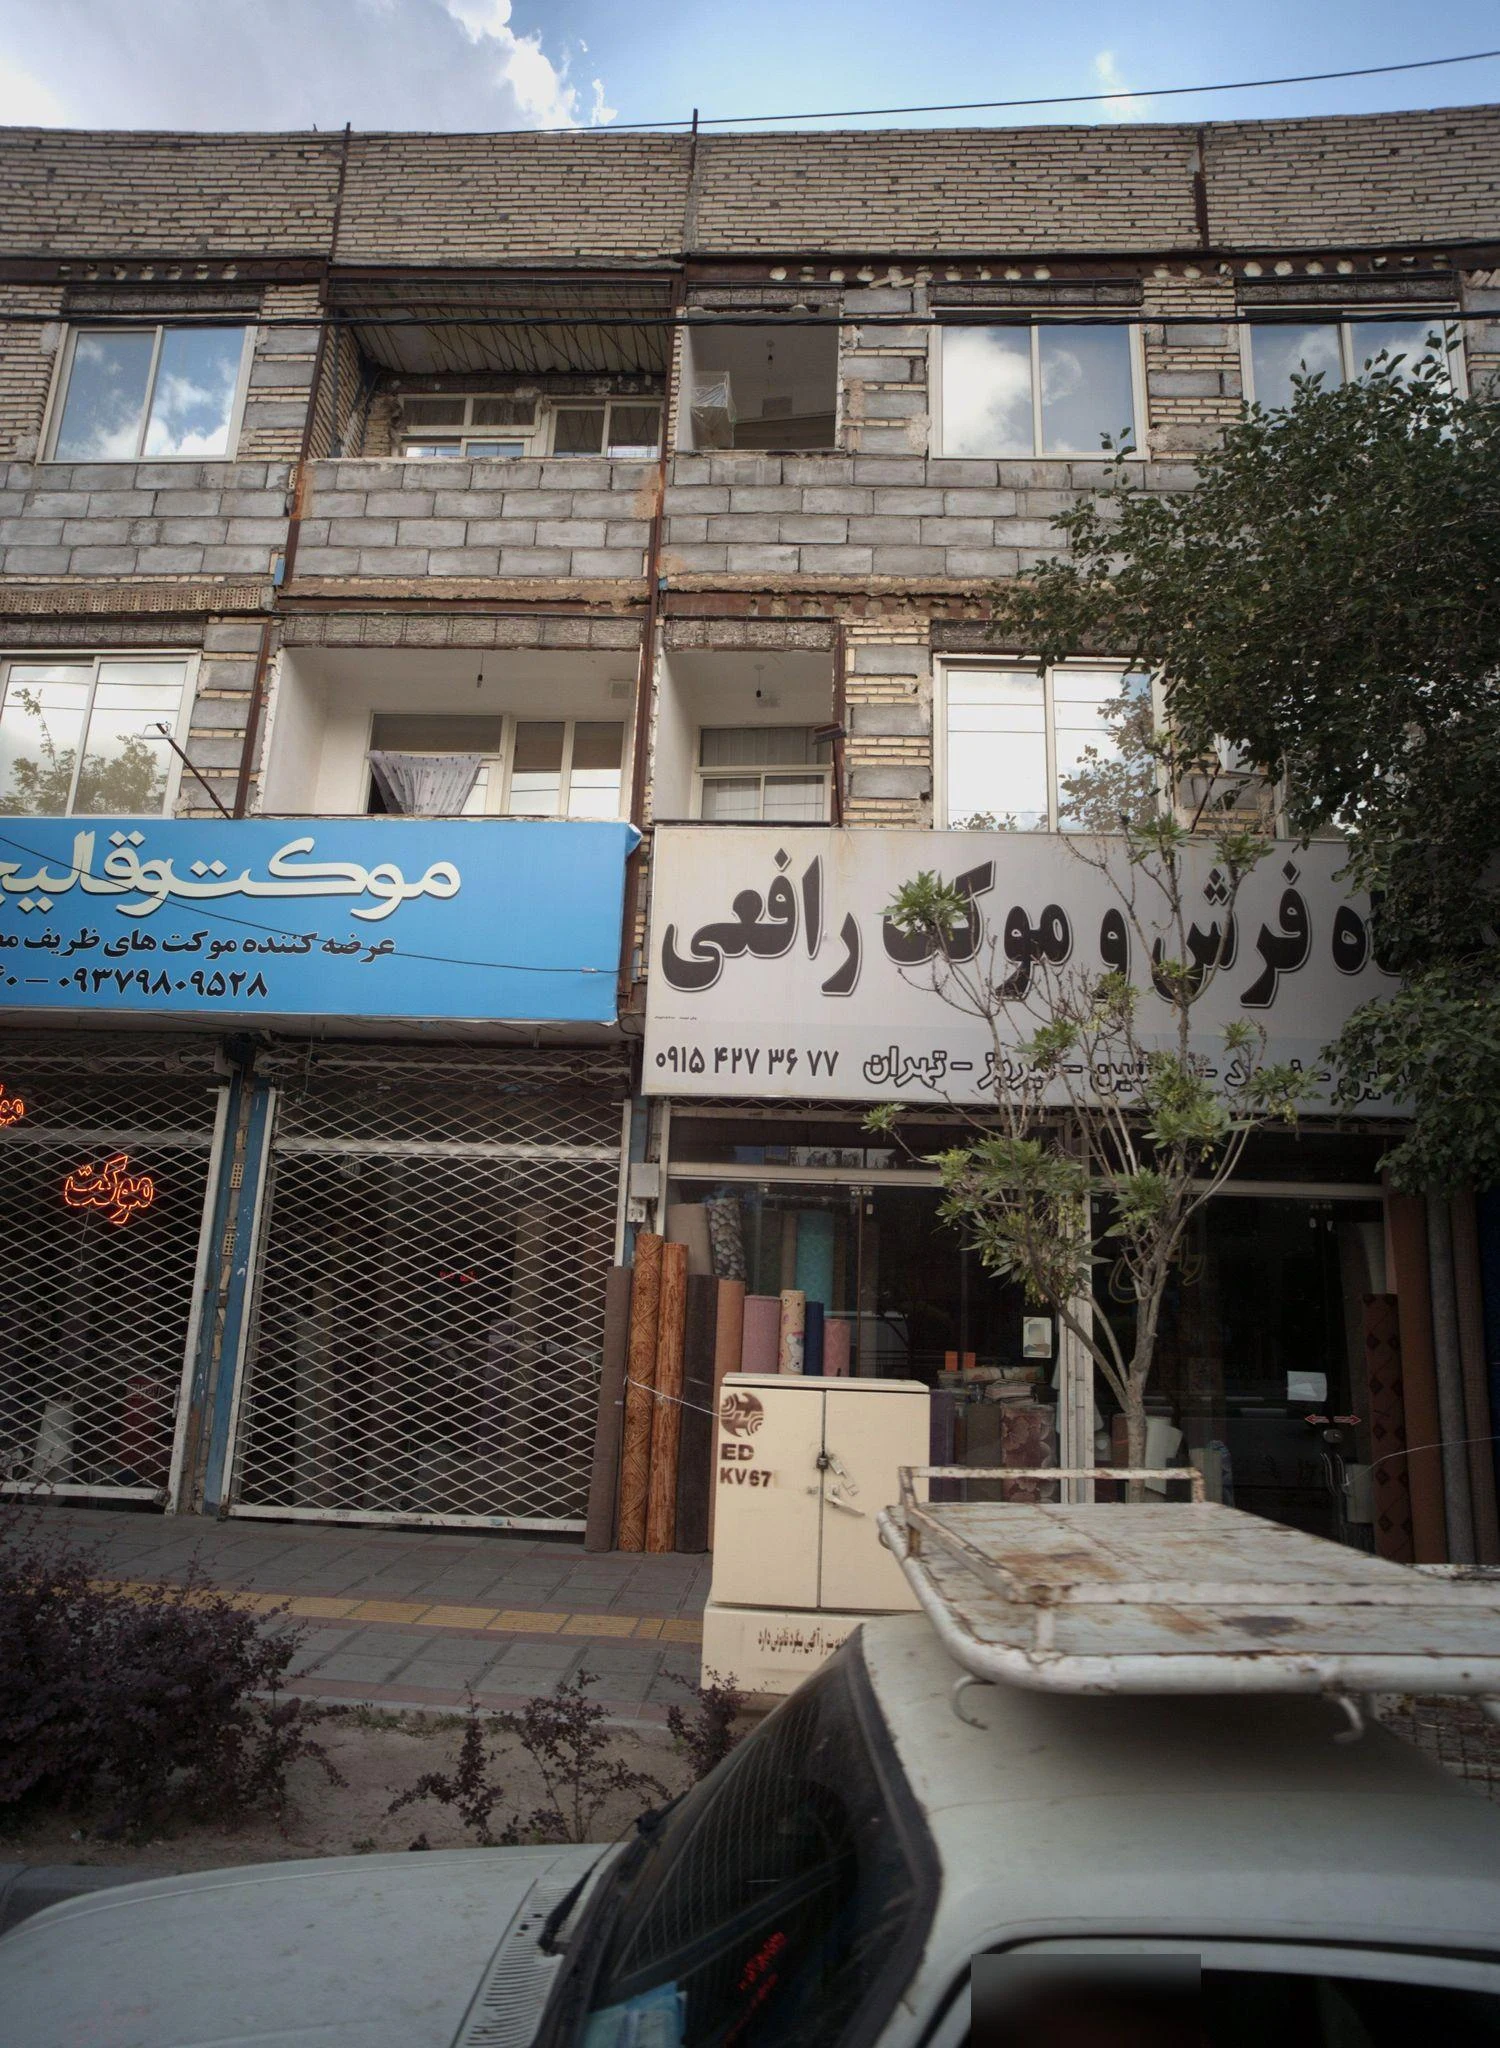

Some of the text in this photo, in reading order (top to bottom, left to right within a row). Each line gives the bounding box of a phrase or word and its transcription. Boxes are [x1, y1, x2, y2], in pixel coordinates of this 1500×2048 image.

[661, 847, 862, 997] رافعی
[1152, 859, 1311, 1008] فرش
[23, 927, 100, 957] ظریف
[103, 929, 157, 958] های
[161, 930, 238, 960] موکت
[242, 932, 318, 955] کننده
[321, 932, 395, 963] عرضه
[1094, 907, 1131, 1003] و
[58, 966, 269, 998] ۰۹۳۷۹۸۰۹۵۲۸
[655, 1046, 840, 1077] ۰۹۱۵ ۴۲۷ ۳۶ ۷۷
[863, 1045, 948, 1088] تهران
[64, 1155, 154, 1224] موکت
[720, 1443, 754, 1461] ED
[719, 1467, 773, 1488] KV67
